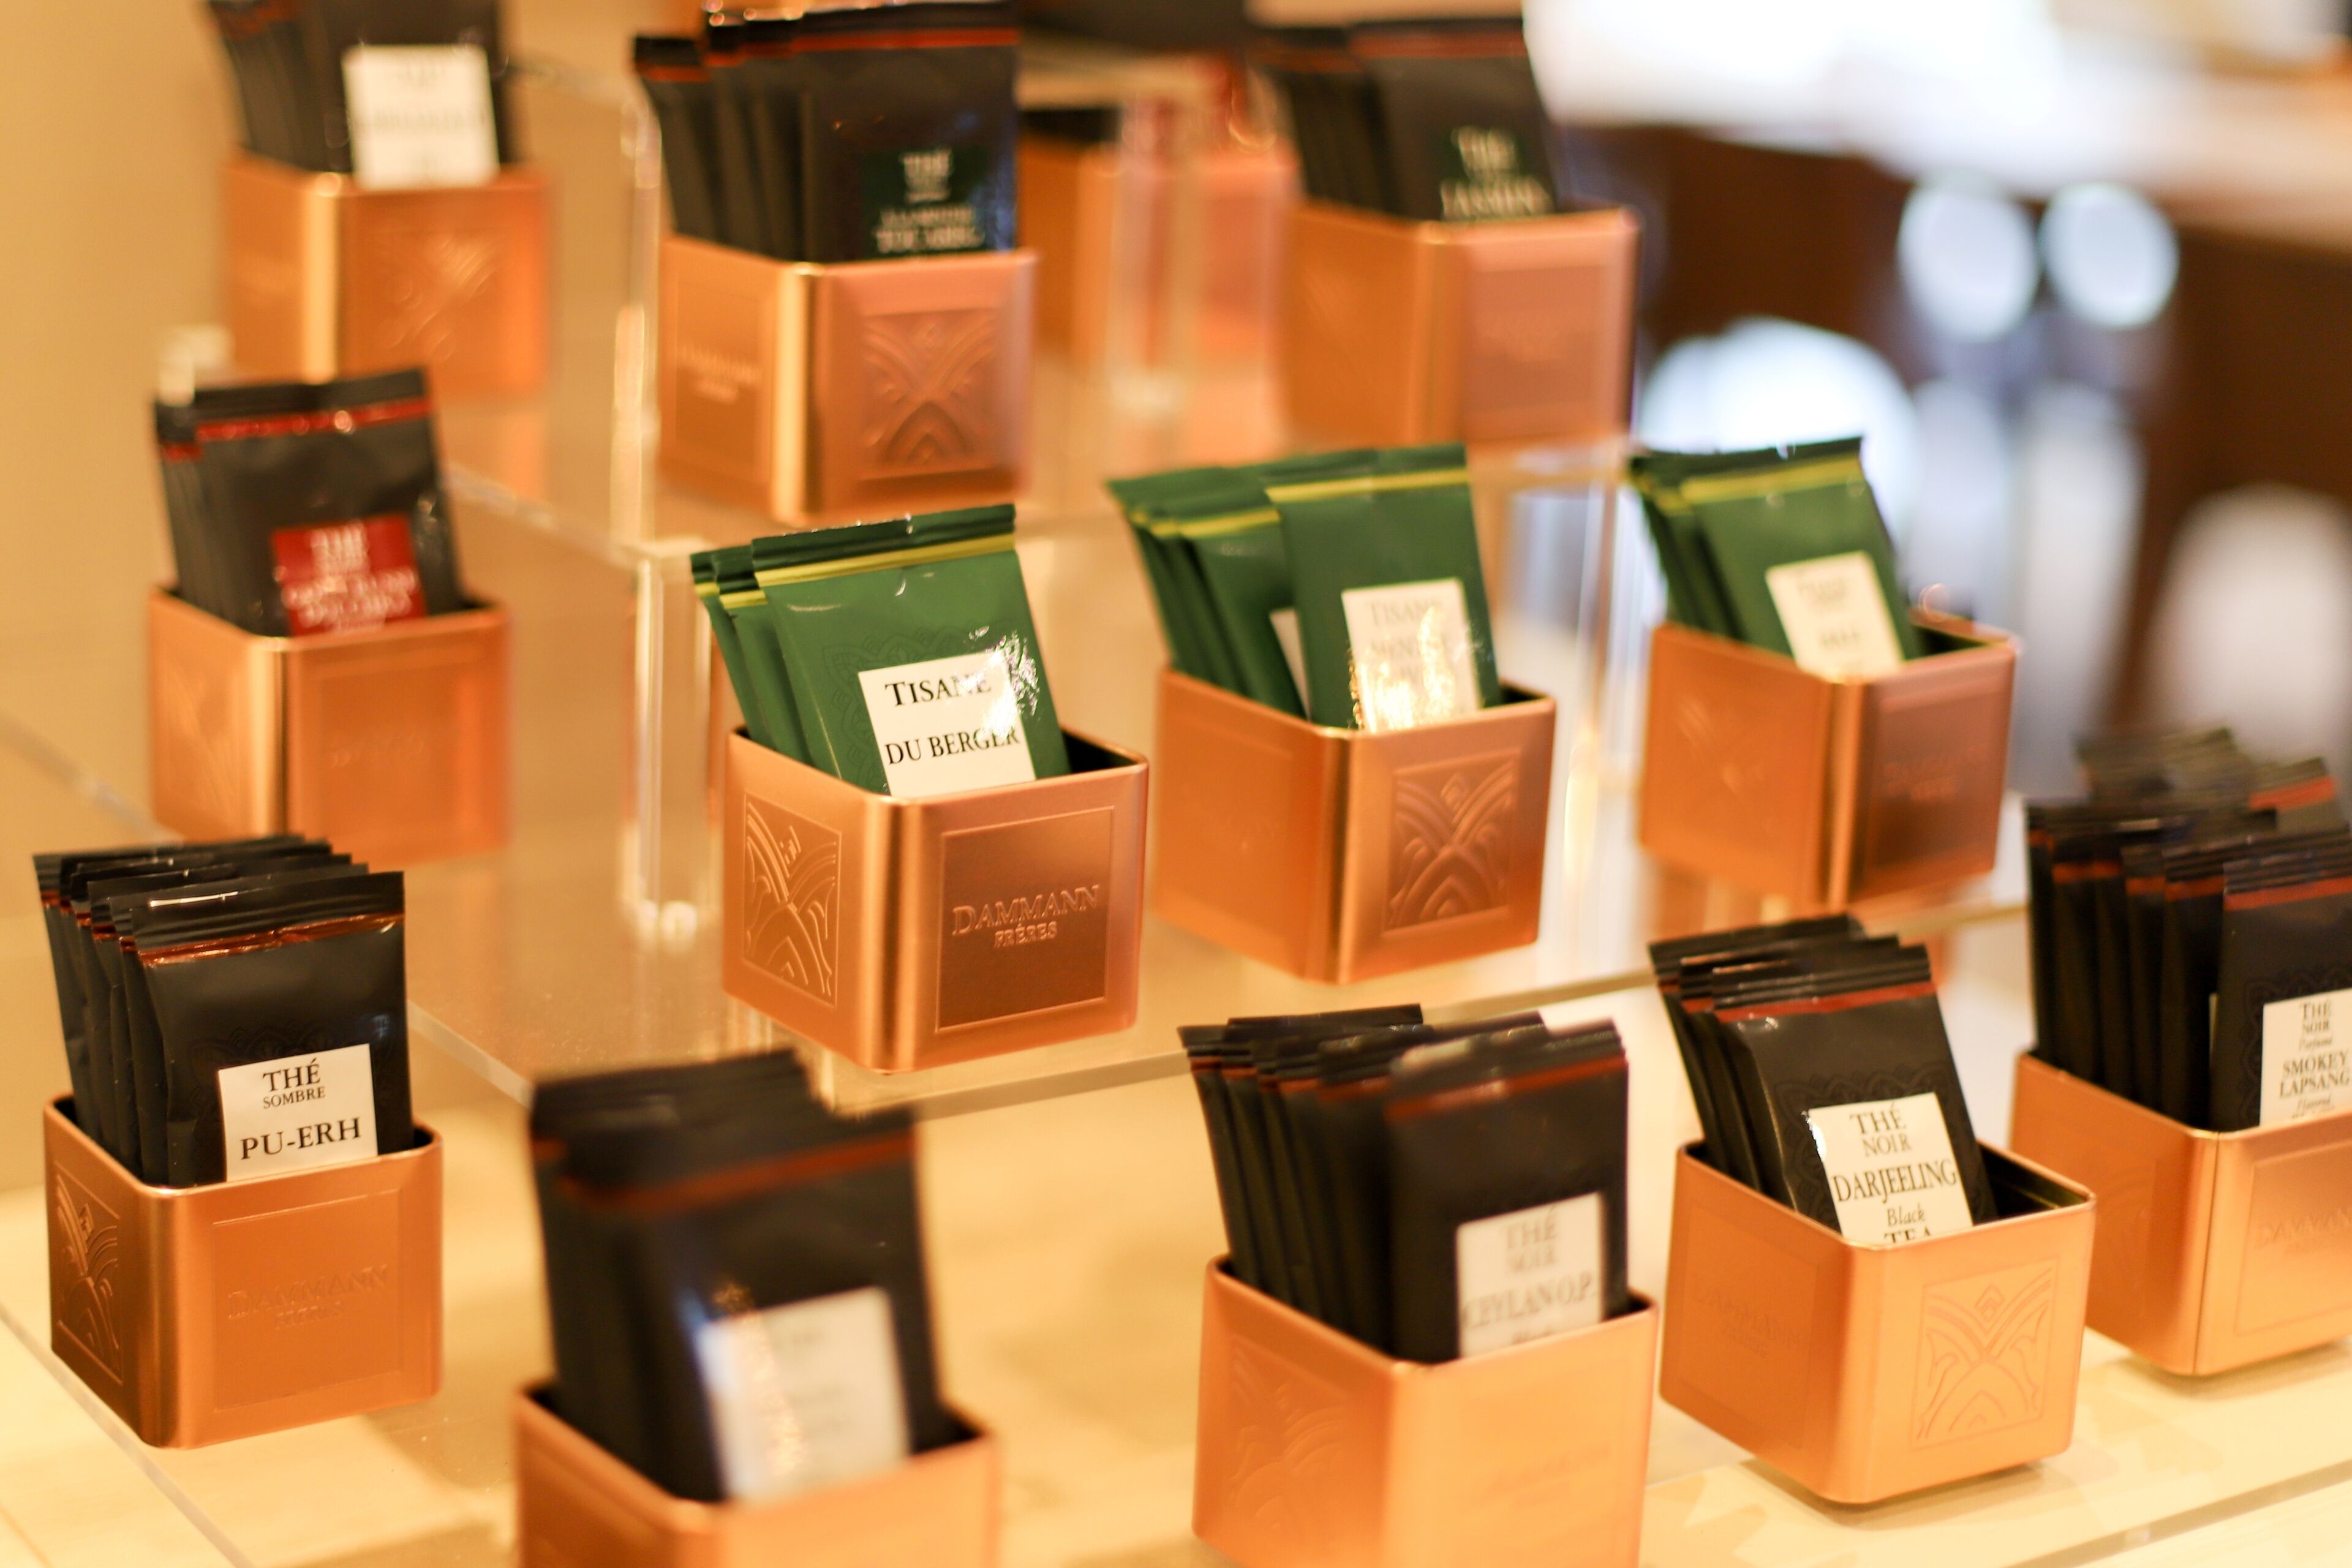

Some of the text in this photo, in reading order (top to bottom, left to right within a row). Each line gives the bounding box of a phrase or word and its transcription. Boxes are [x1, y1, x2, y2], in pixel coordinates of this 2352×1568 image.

[884, 726, 1021, 765] DU BERGER
[952, 884, 1100, 936] DAMMANN
[262, 1057, 321, 1092] THÉ
[2282, 1049, 2348, 1078] SMOKEY
[263, 1086, 326, 1109] SOMBRE
[2278, 1069, 2351, 1099] LAPSANG
[1850, 1102, 1905, 1134] THÉ
[240, 1117, 363, 1160] PU-ERH
[1862, 1134, 1912, 1156] NOIR
[1832, 1159, 1957, 1204] DARJEELING
[1887, 1202, 1925, 1227] Black
[227, 1263, 388, 1321] DAMMANN
